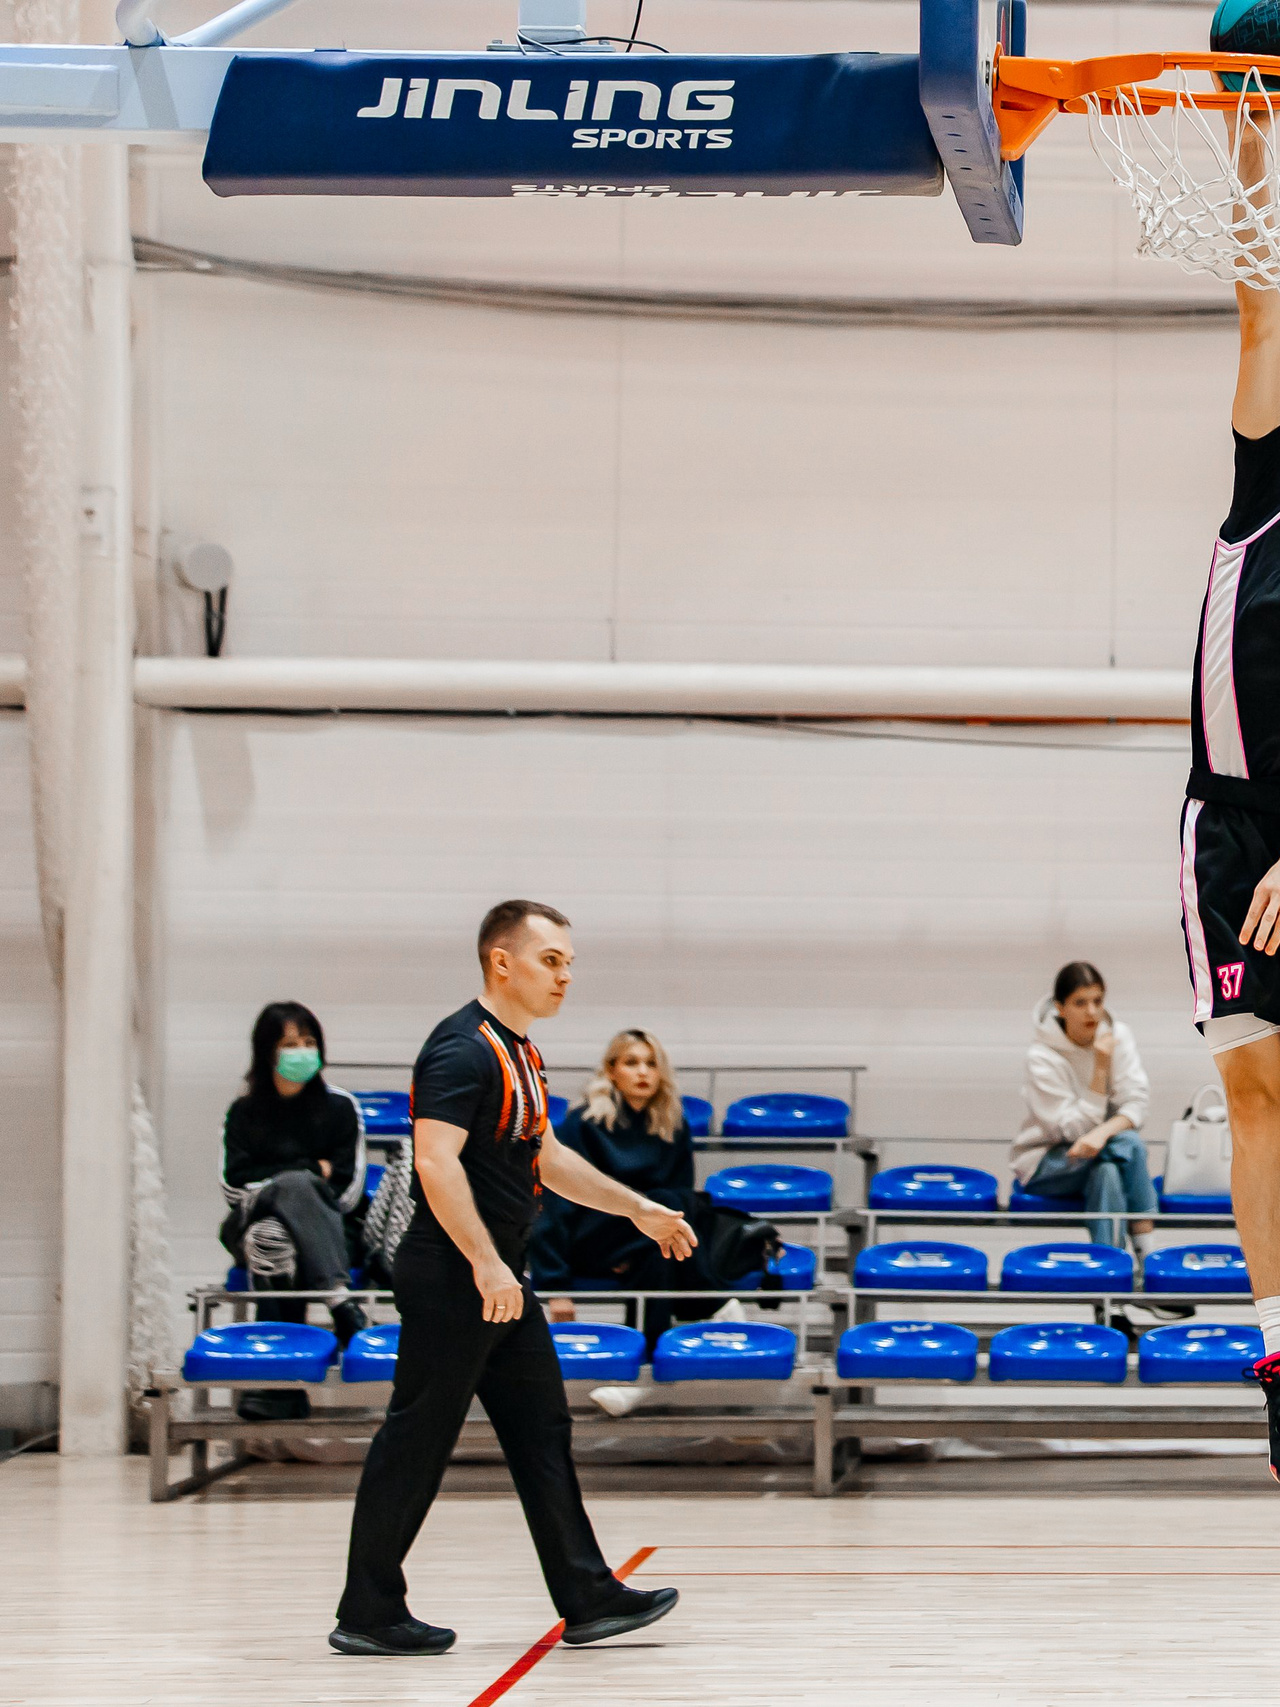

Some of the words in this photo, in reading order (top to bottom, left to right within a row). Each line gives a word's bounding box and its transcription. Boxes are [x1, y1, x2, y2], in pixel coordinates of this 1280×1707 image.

[357, 78, 735, 121] JINLING
[571, 128, 734, 150] SPORTS
[1217, 961, 1245, 1000] 37
